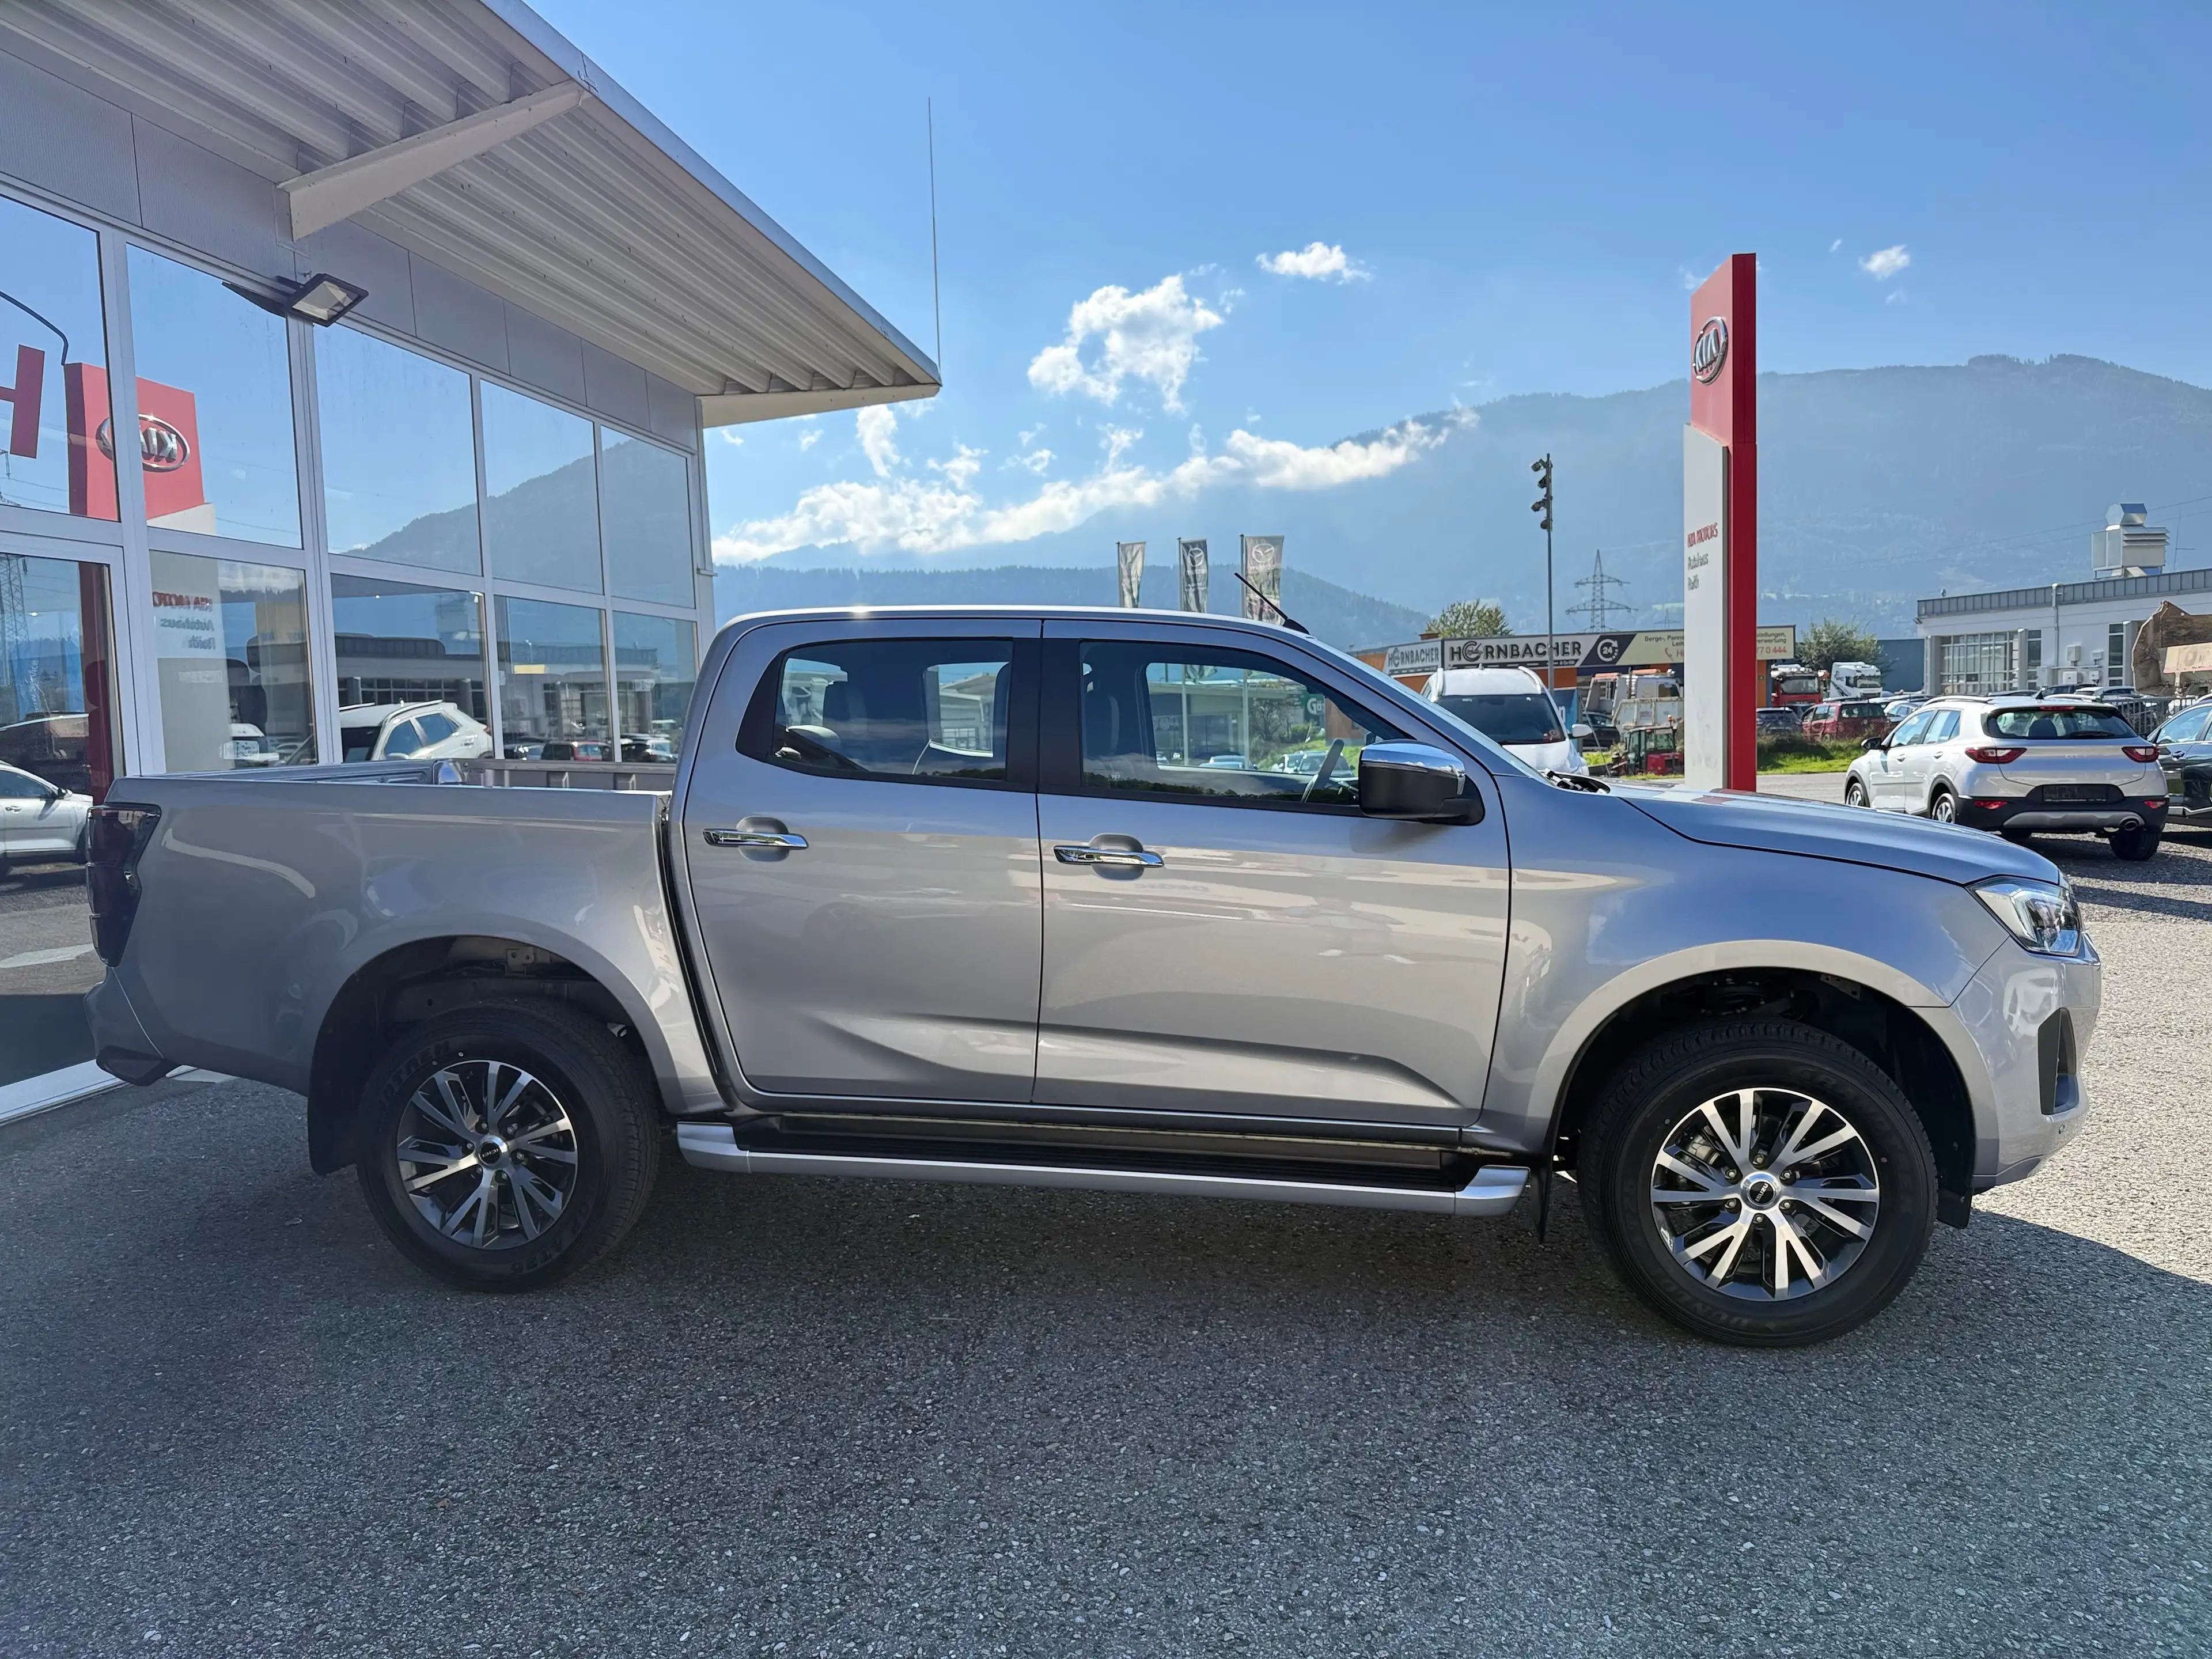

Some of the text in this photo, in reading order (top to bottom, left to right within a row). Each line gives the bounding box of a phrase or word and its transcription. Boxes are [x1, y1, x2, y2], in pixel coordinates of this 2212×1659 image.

[1695, 328, 1719, 372] KIA
[1696, 522, 1718, 544] MOTORS
[1388, 647, 1439, 667] HORNBACHER
[1449, 641, 1581, 662] HORNBACHER
[1603, 646, 1613, 654] 24
[1755, 1183, 1769, 1202] ISUZU
